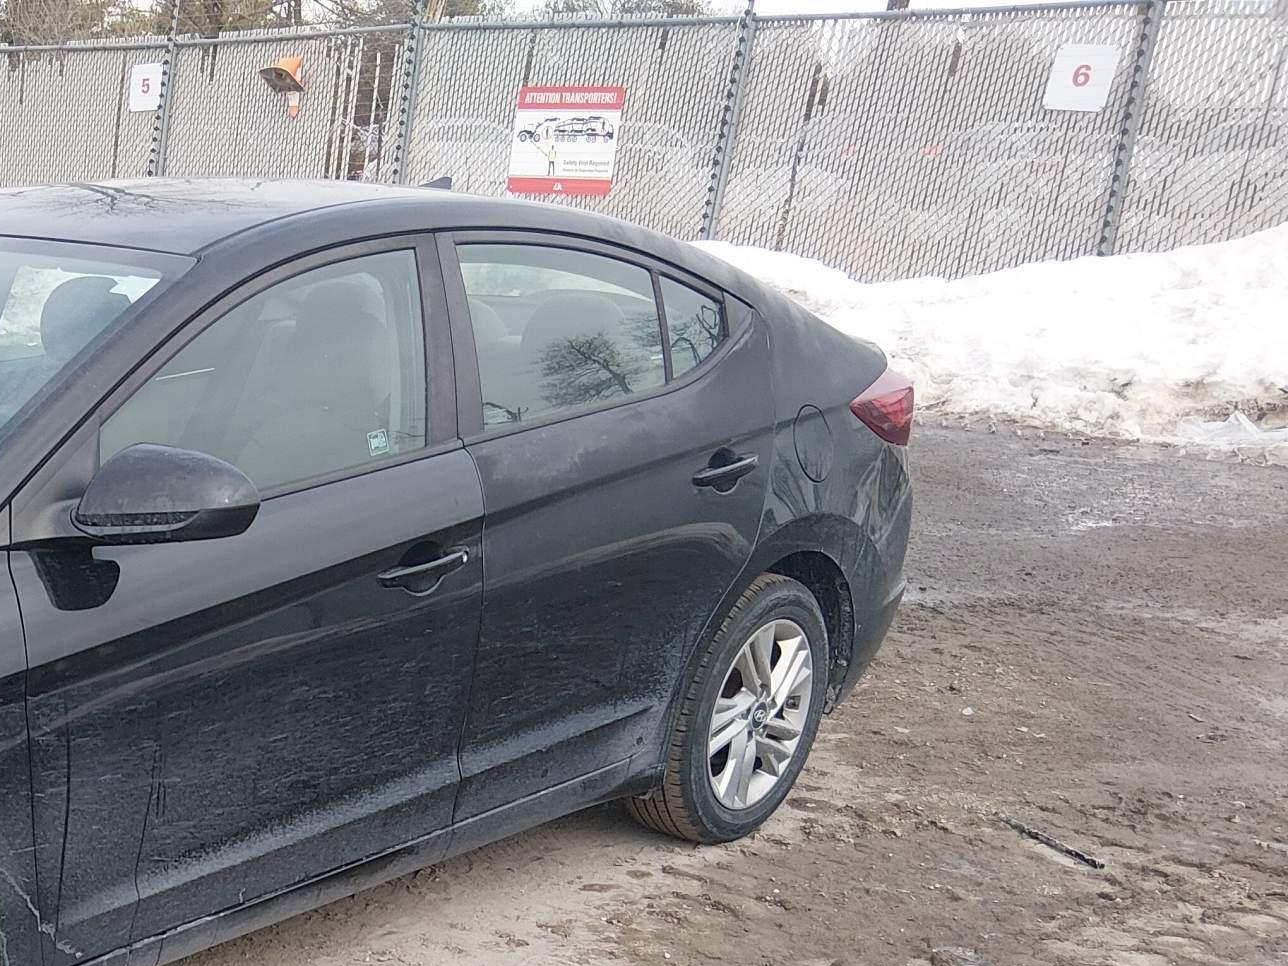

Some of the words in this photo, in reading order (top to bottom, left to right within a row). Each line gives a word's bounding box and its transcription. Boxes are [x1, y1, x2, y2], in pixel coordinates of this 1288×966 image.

[1072, 64, 1092, 88] 6
[141, 78, 151, 94] 5
[524, 92, 561, 104] ATTENTION
[562, 92, 617, 104] TRANSPORTERS!
